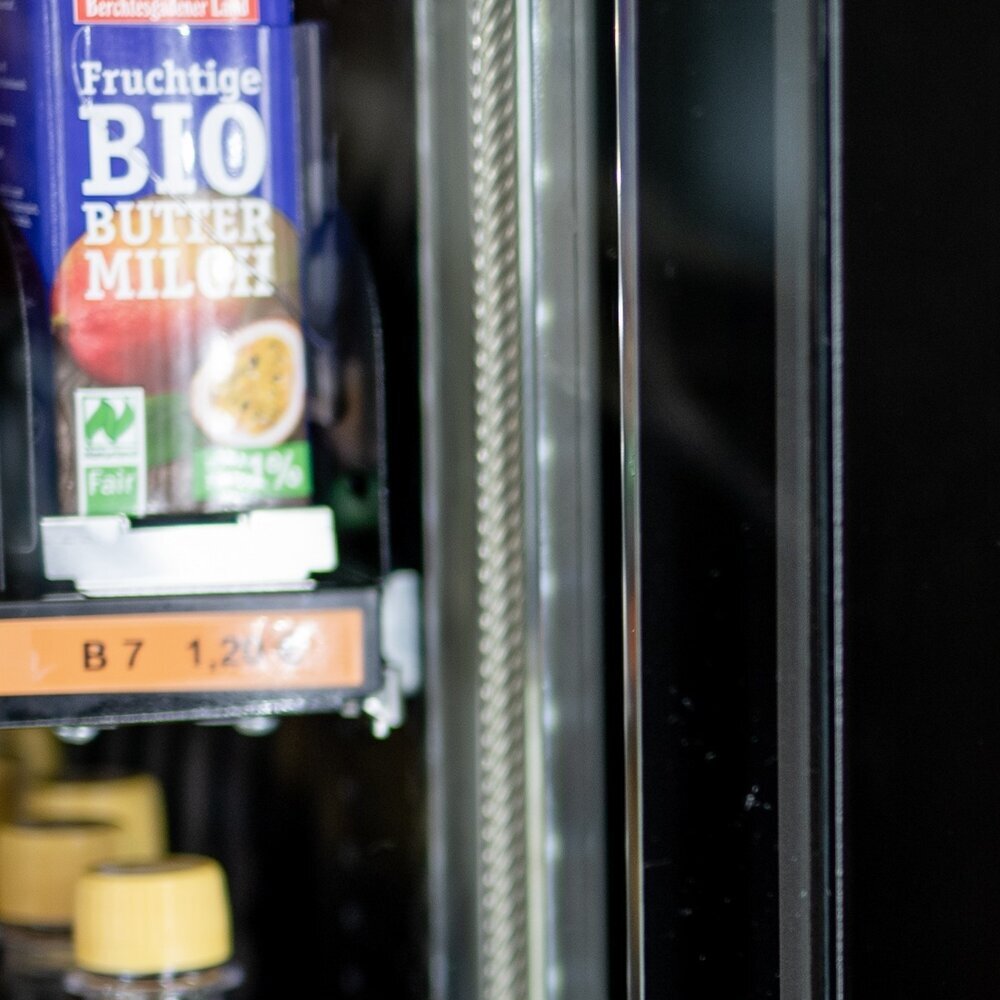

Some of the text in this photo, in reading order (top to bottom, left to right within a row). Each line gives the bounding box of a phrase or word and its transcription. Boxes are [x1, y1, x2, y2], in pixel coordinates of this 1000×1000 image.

[80, 60, 262, 101] Fruchtige
[79, 102, 266, 197] BIO
[81, 199, 275, 246] BUTTER
[84, 246, 275, 300] MILCH
[88, 468, 137, 497] Fair
[82, 639, 107, 671] B
[123, 638, 144, 670] 7
